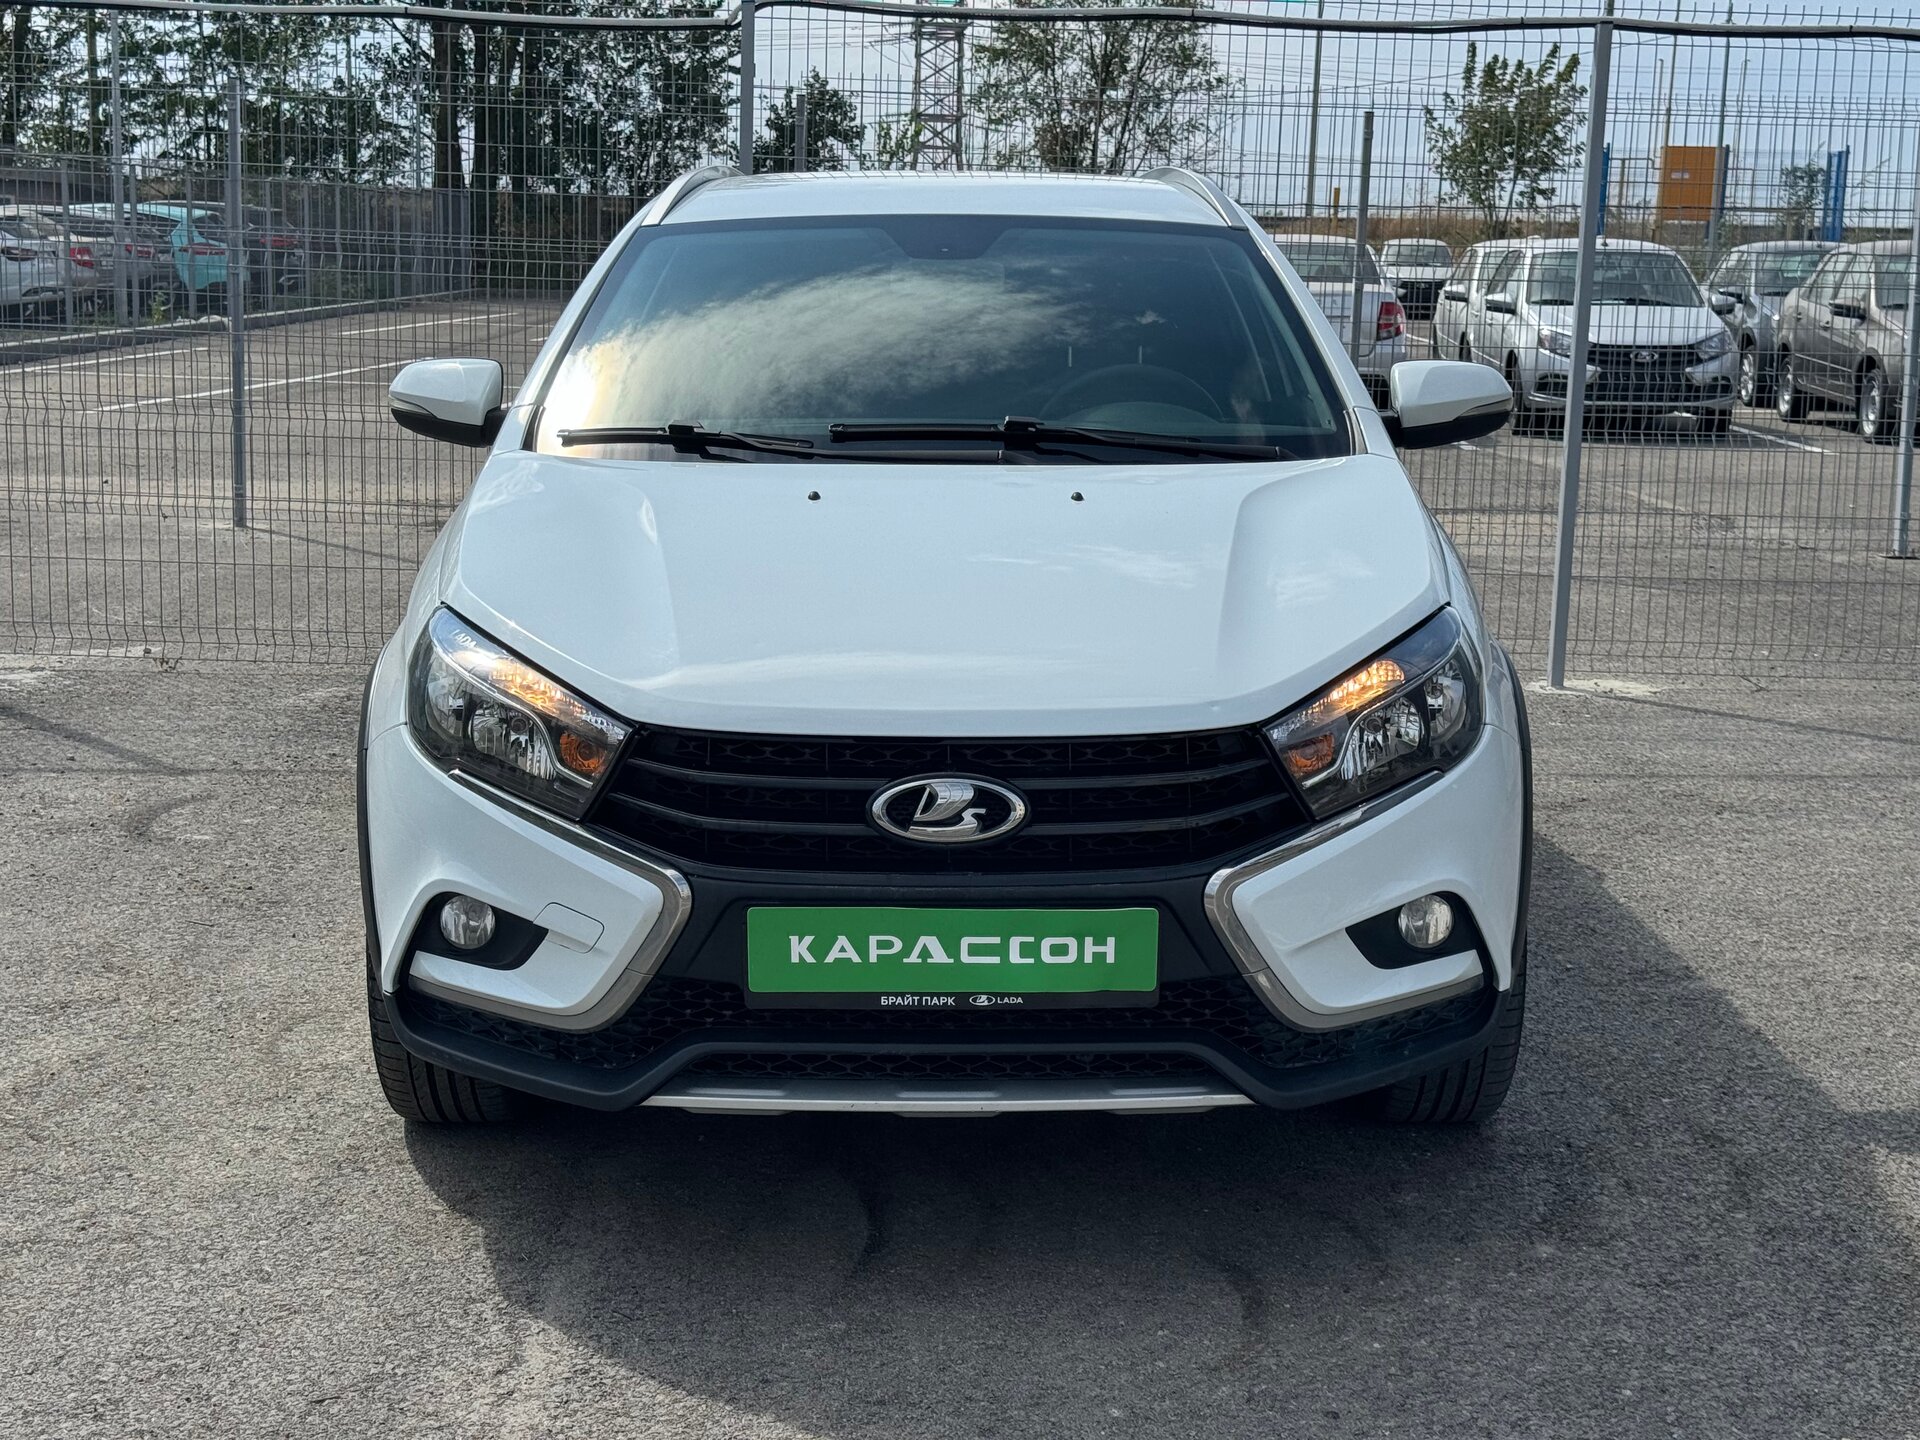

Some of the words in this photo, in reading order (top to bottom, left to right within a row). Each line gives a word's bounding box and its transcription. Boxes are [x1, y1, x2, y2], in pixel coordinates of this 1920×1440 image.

[788, 935, 1116, 964] КАРЛССОН
[880, 994, 920, 1006] БРАЙТ
[922, 996, 956, 1006] ПАРК
[997, 996, 1024, 1004] LADA
